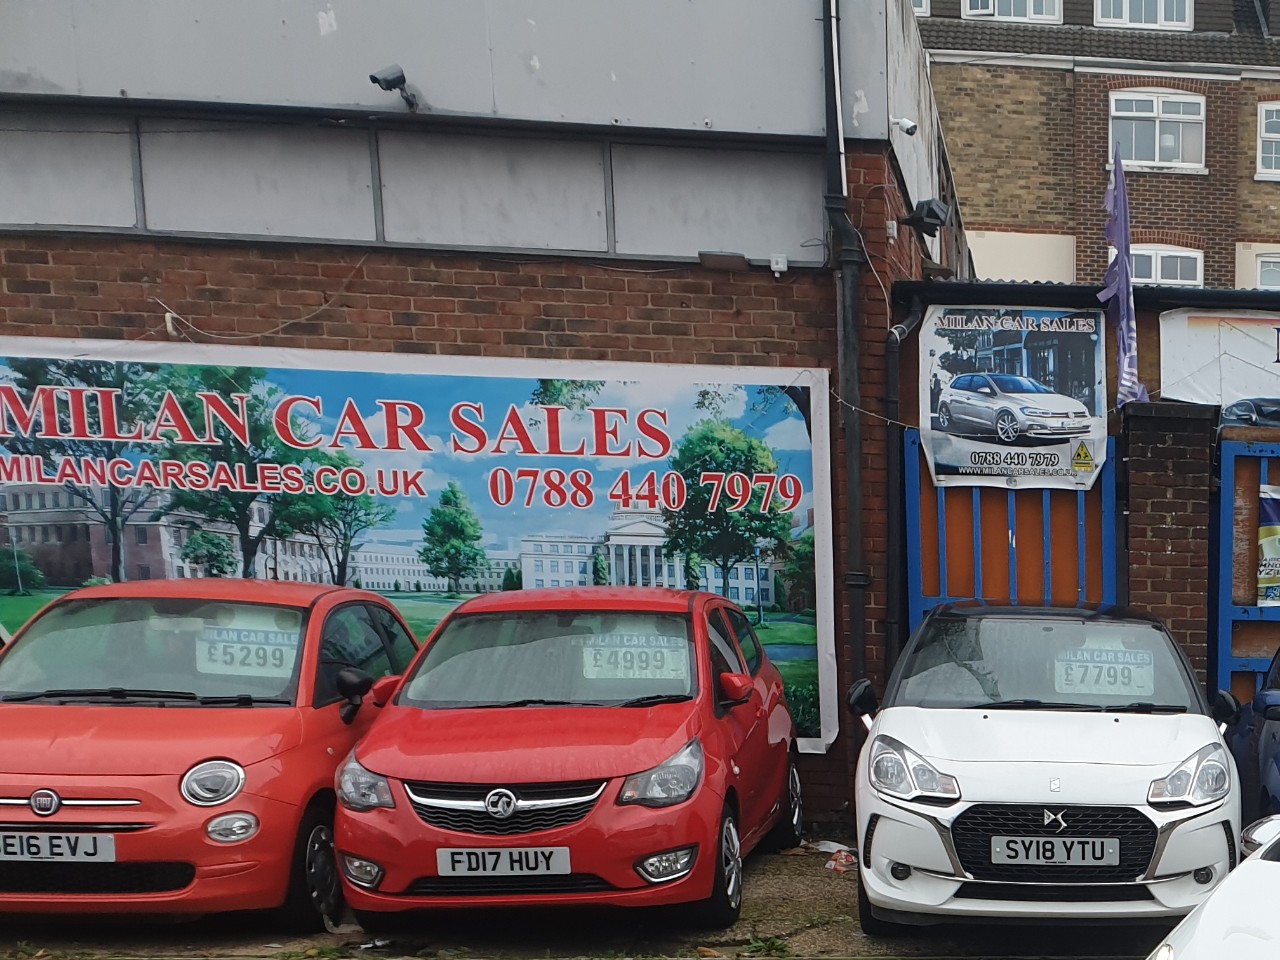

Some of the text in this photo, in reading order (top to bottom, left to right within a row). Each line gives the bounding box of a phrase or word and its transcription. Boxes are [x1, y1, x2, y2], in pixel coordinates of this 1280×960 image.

[937, 315, 1095, 332] MILAN CAR SALES
[0, 385, 672, 459] MILAN CAR SALES
[971, 451, 1001, 466] 0788
[1003, 452, 1027, 467] 440
[1029, 453, 1060, 467] 7979
[0, 453, 428, 497] MILANCARSALES.CO.UK
[488, 467, 804, 514] 0788 440 7979
[204, 630, 299, 645] ILAN CAR SALE
[623, 637, 646, 647] CAR
[207, 643, 284, 669] £5299
[592, 649, 665, 670] £4999
[1093, 651, 1115, 663] CAR
[1117, 652, 1150, 664] SALES
[1064, 664, 1132, 686] £7799
[36, 797, 52, 808] FIAT
[0, 834, 98, 857] E16 EVJ
[1005, 840, 1105, 860] SY18 YTU
[450, 850, 554, 872] FD17 HUY
